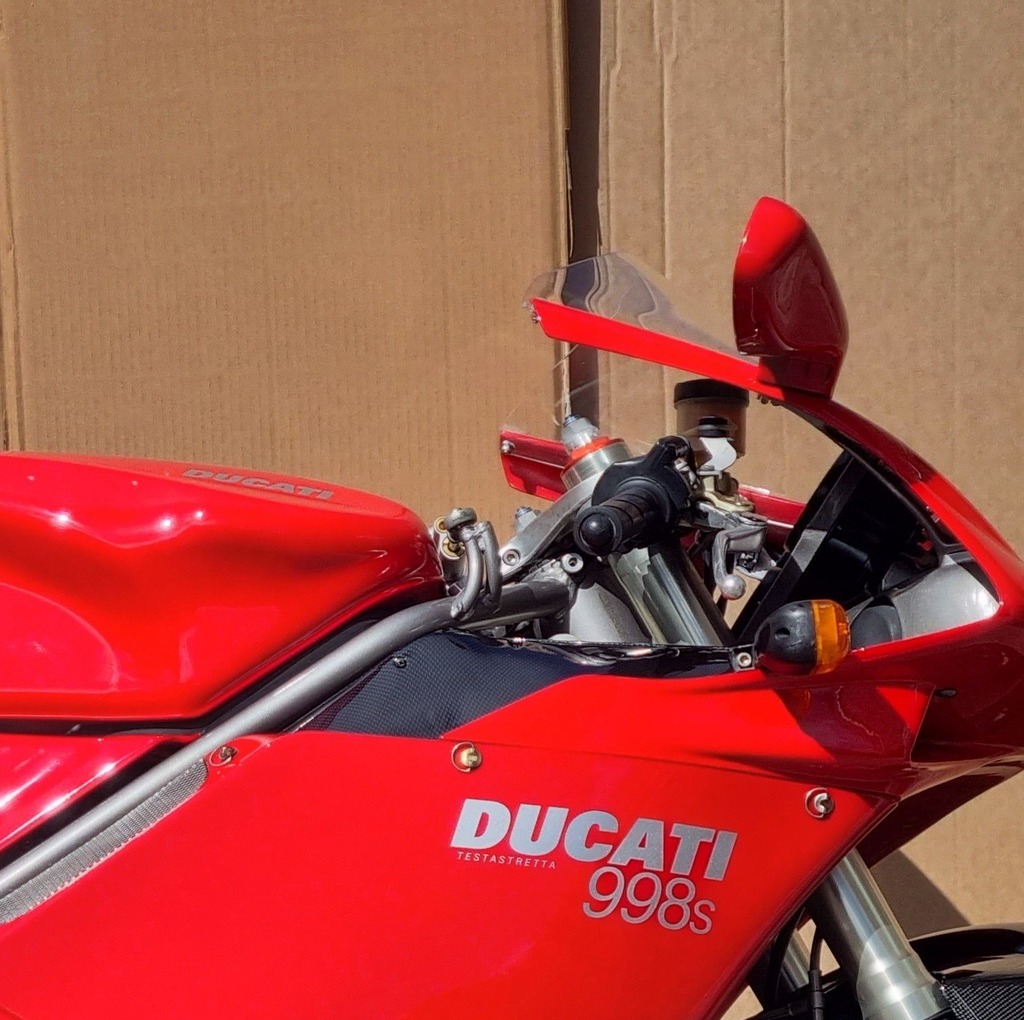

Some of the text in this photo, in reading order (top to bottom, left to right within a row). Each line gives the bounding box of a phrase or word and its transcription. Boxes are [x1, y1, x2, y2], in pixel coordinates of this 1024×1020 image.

[182, 468, 335, 500] DUCATI
[450, 798, 738, 881] DUCATI
[456, 850, 557, 870] TESTASTRETTA
